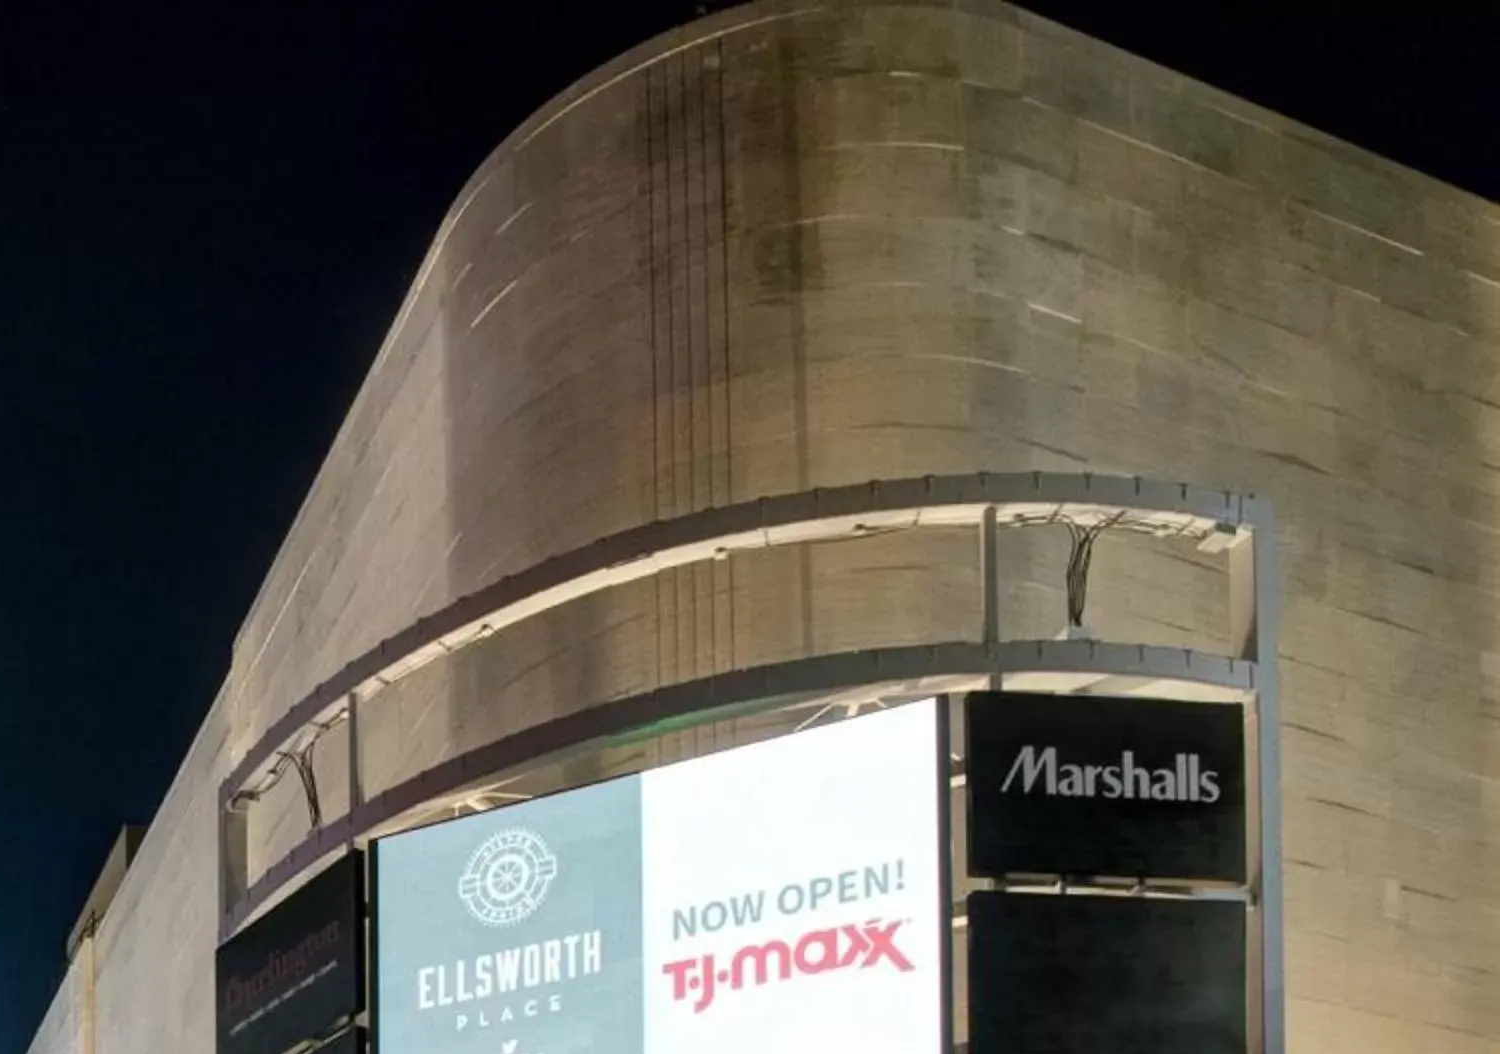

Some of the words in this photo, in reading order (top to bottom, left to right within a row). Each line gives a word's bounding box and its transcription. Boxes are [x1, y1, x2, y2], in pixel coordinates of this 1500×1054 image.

[1001, 745, 1220, 803] Marshalls
[672, 890, 765, 942] NOW
[777, 858, 905, 916] OPEN!
[419, 929, 601, 1010] ELLSWORTH
[456, 994, 562, 1031] PLACE
